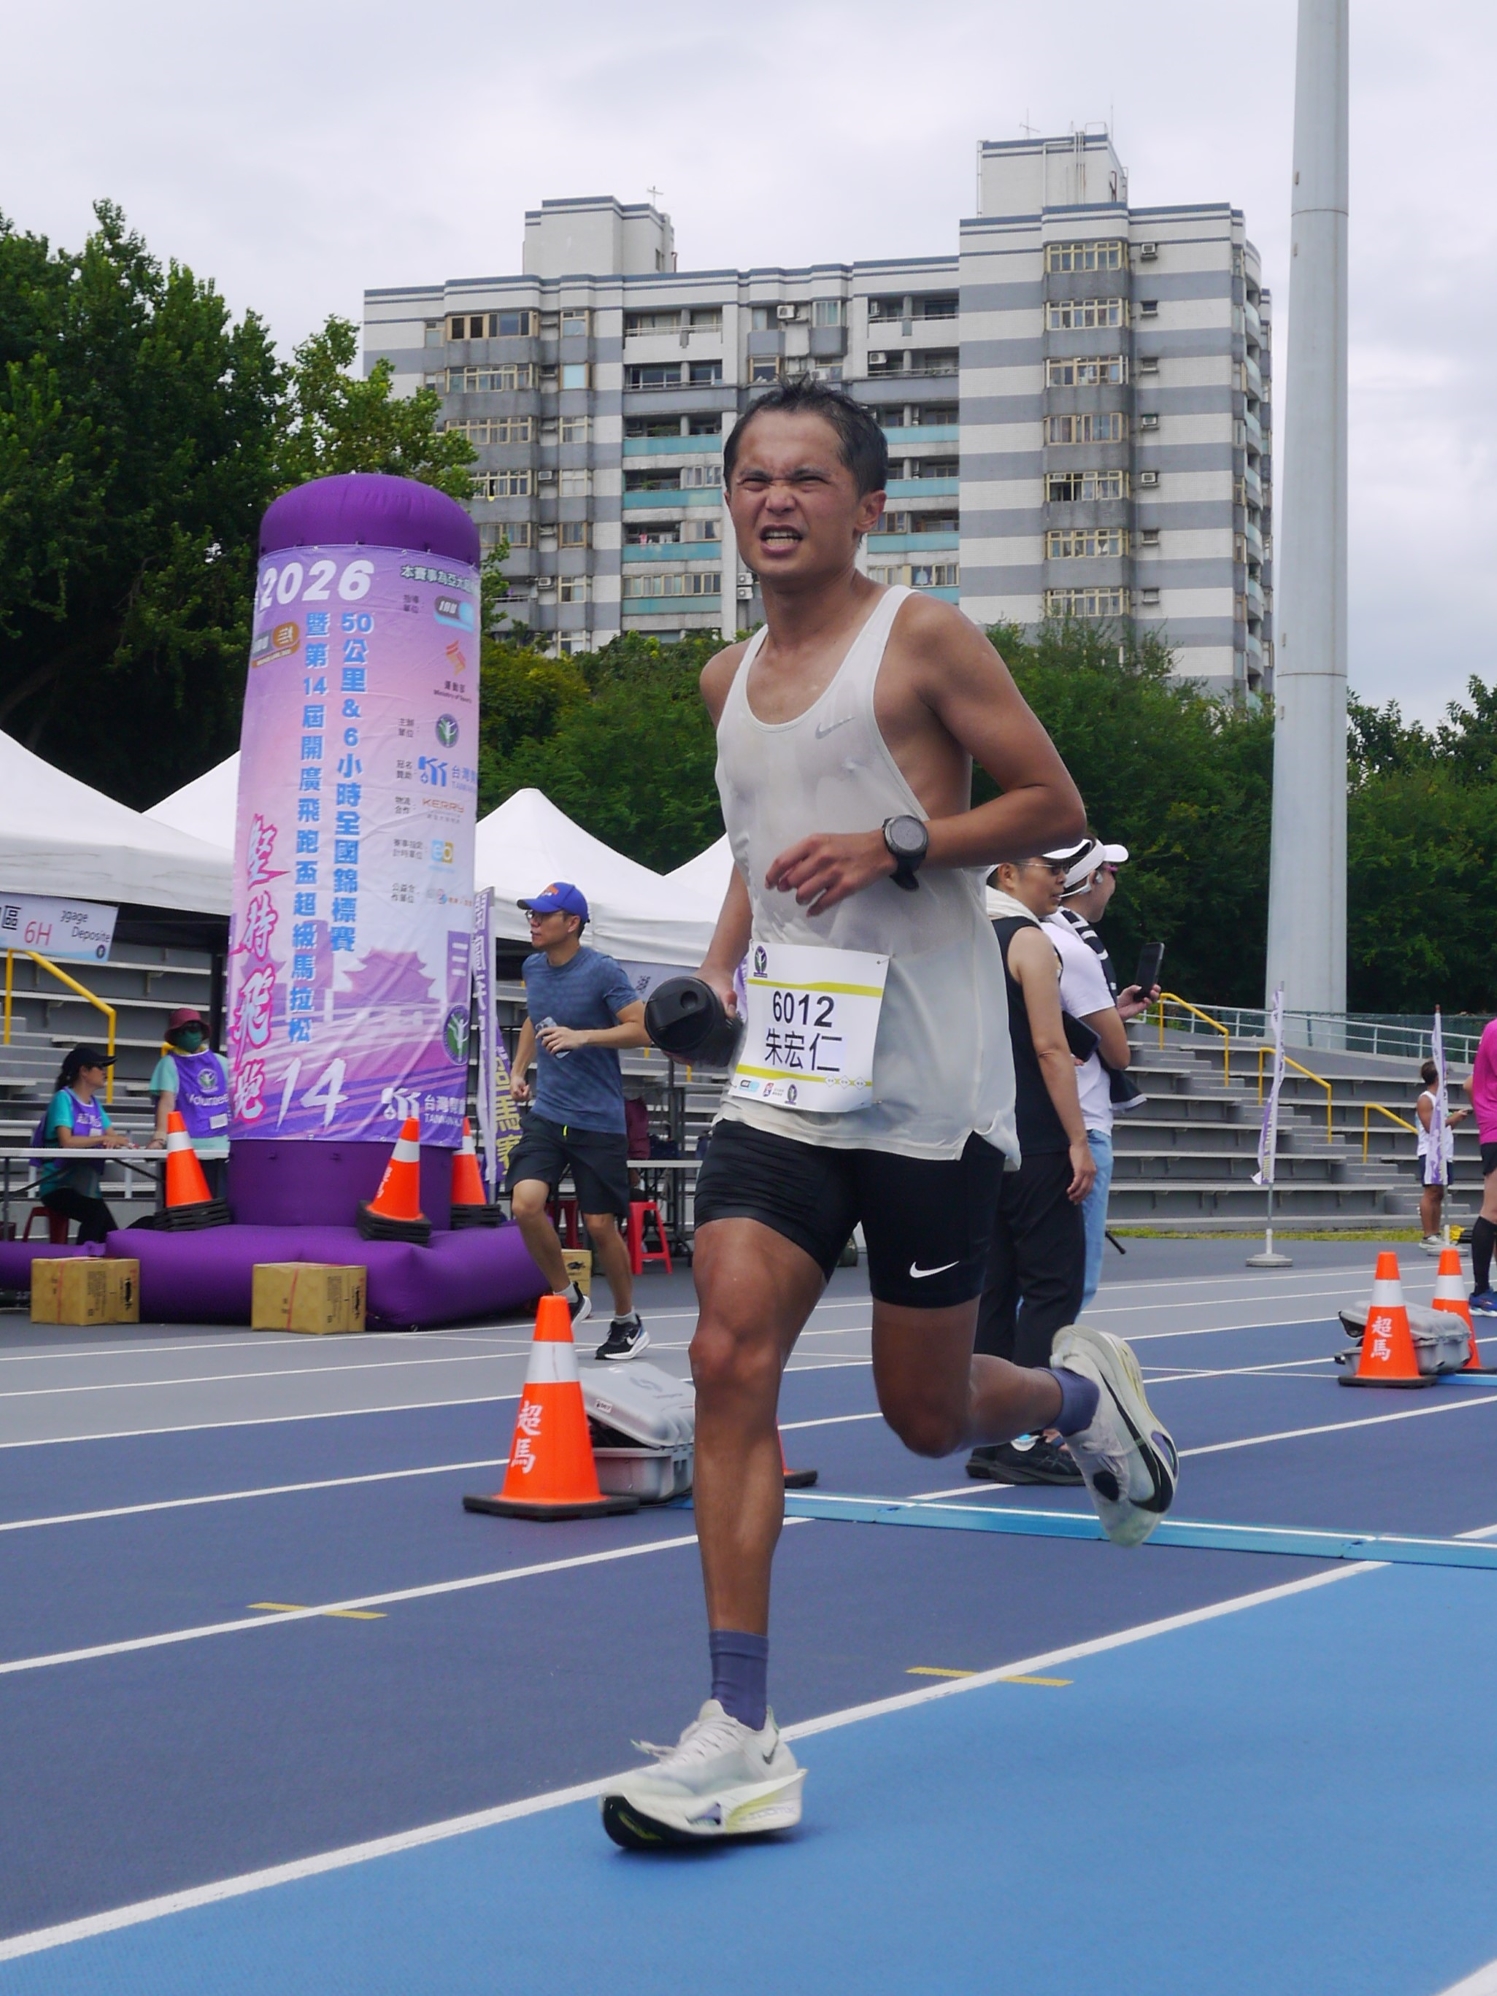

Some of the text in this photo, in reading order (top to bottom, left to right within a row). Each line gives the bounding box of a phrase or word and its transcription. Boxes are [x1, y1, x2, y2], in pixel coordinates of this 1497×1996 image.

[259, 560, 375, 610] 2026
[422, 798, 464, 813] KERRY
[24, 921, 53, 946] 6H
[71, 926, 111, 943] Deposite
[773, 990, 835, 1028] 6012
[765, 1028, 842, 1072] 朱宏仁
[275, 1057, 349, 1132] 14
[1370, 1316, 1393, 1362] 超馬
[511, 1401, 543, 1474] 超馬
